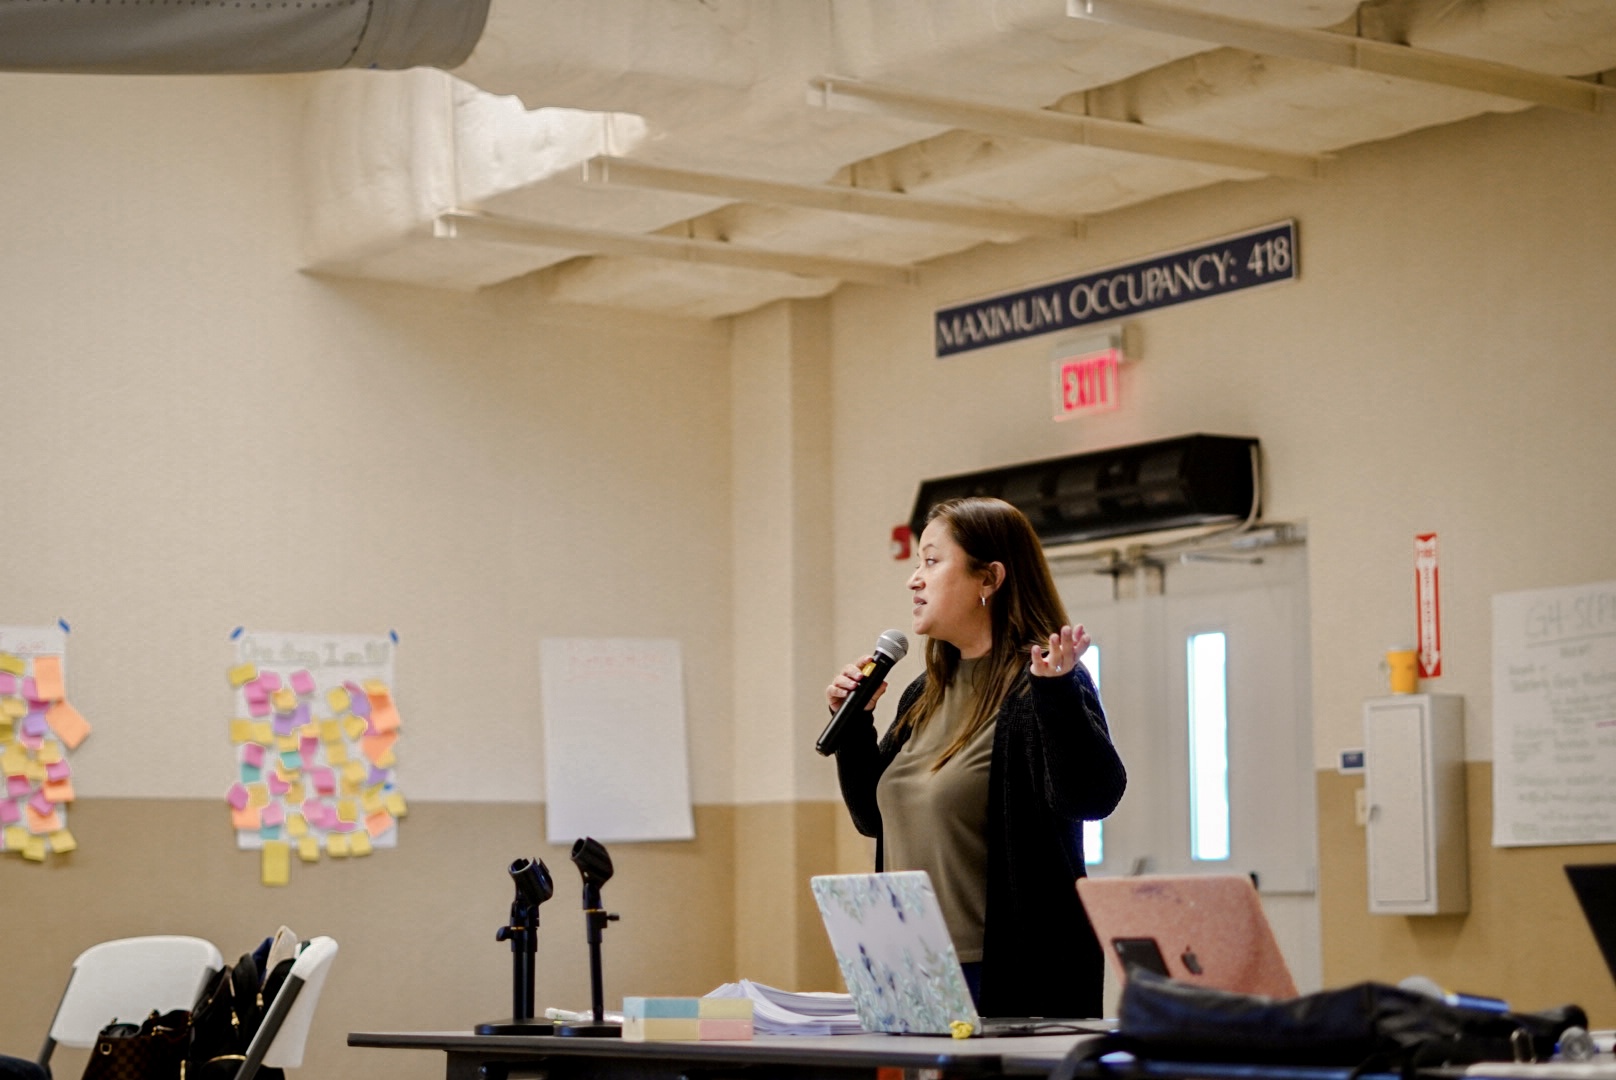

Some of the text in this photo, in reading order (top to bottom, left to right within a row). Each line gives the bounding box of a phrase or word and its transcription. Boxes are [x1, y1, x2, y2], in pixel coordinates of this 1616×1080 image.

[938, 236, 1291, 347] MAXIMUM OCCUPANCY: 418
[1062, 354, 1112, 412] EXIT
